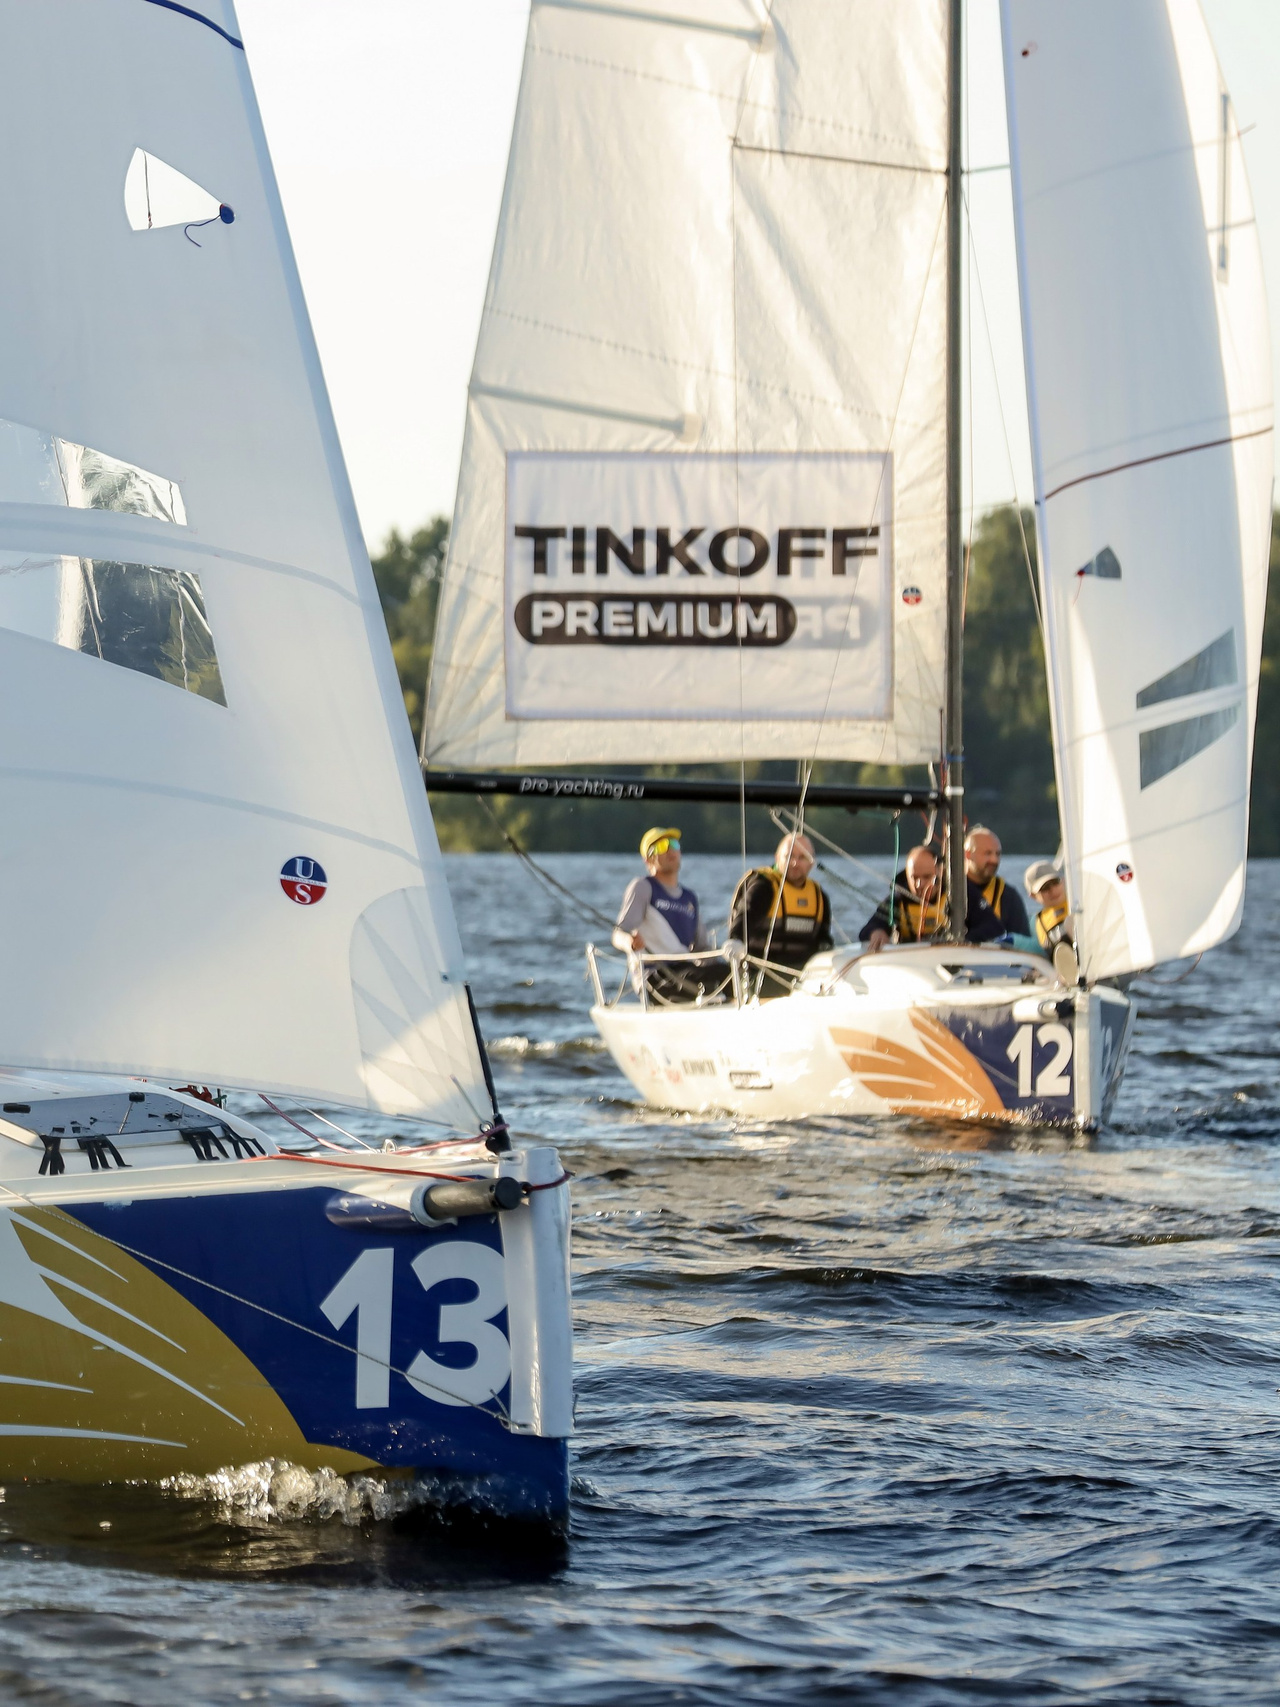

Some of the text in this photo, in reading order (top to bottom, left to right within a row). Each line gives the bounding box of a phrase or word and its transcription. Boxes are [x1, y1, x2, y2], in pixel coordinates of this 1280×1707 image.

[515, 526, 880, 576] TINKOFF
[531, 600, 778, 640] PREMIUM
[521, 776, 646, 799] pro-yachting.ru
[1006, 1023, 1073, 1098] 12
[320, 1240, 512, 1409] 13
